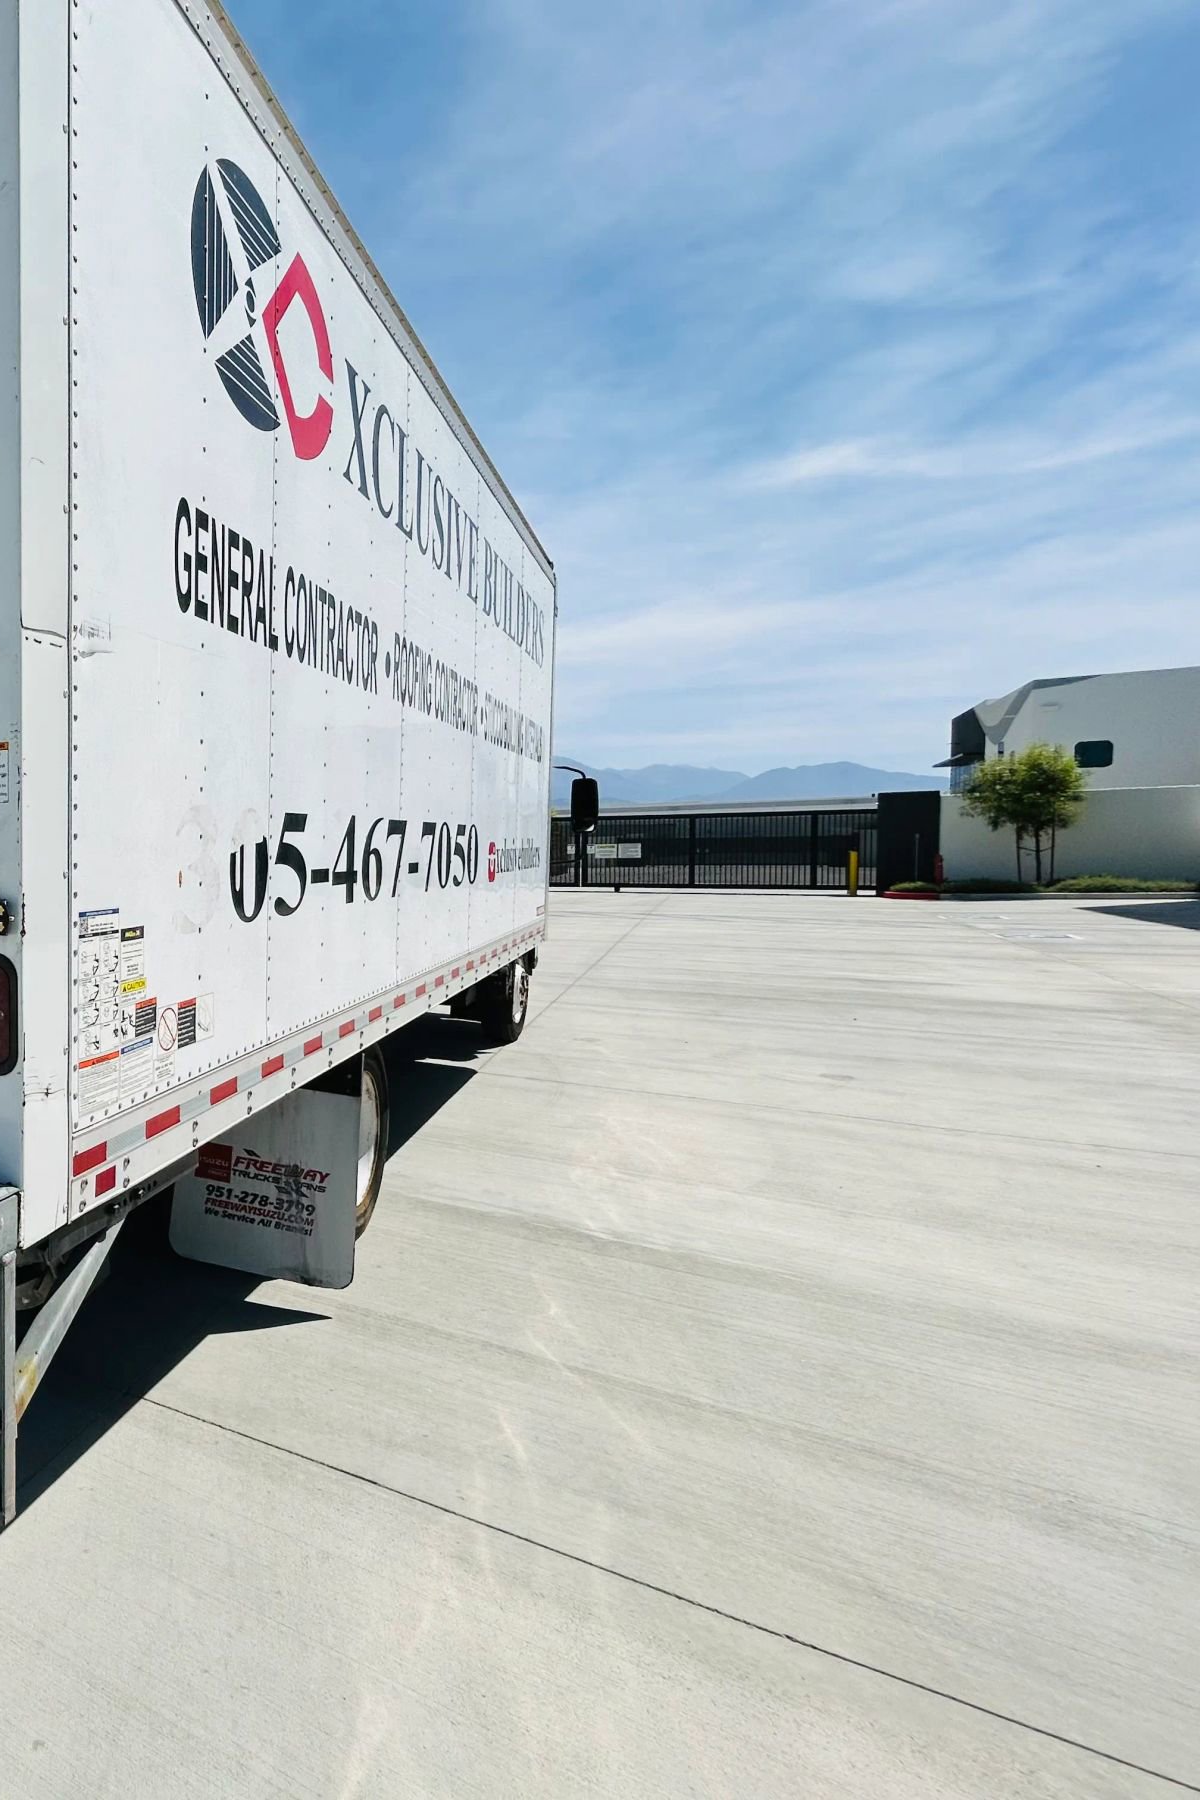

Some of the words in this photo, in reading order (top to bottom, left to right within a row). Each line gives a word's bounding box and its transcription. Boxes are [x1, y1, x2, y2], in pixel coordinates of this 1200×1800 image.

[174, 496, 279, 652] GENERAL
[284, 565, 378, 695] CONTRACTOR
[393, 632, 433, 716] ROOFING
[434, 659, 479, 737] CONTRACTOR
[482, 537, 545, 669] BUILDERS
[231, 1167, 281, 1185] TRUCKS
[233, 1155, 331, 1184] FREEWAY
[204, 1206, 220, 1217] We
[221, 1208, 256, 1226] Service
[257, 1217, 272, 1229] All
